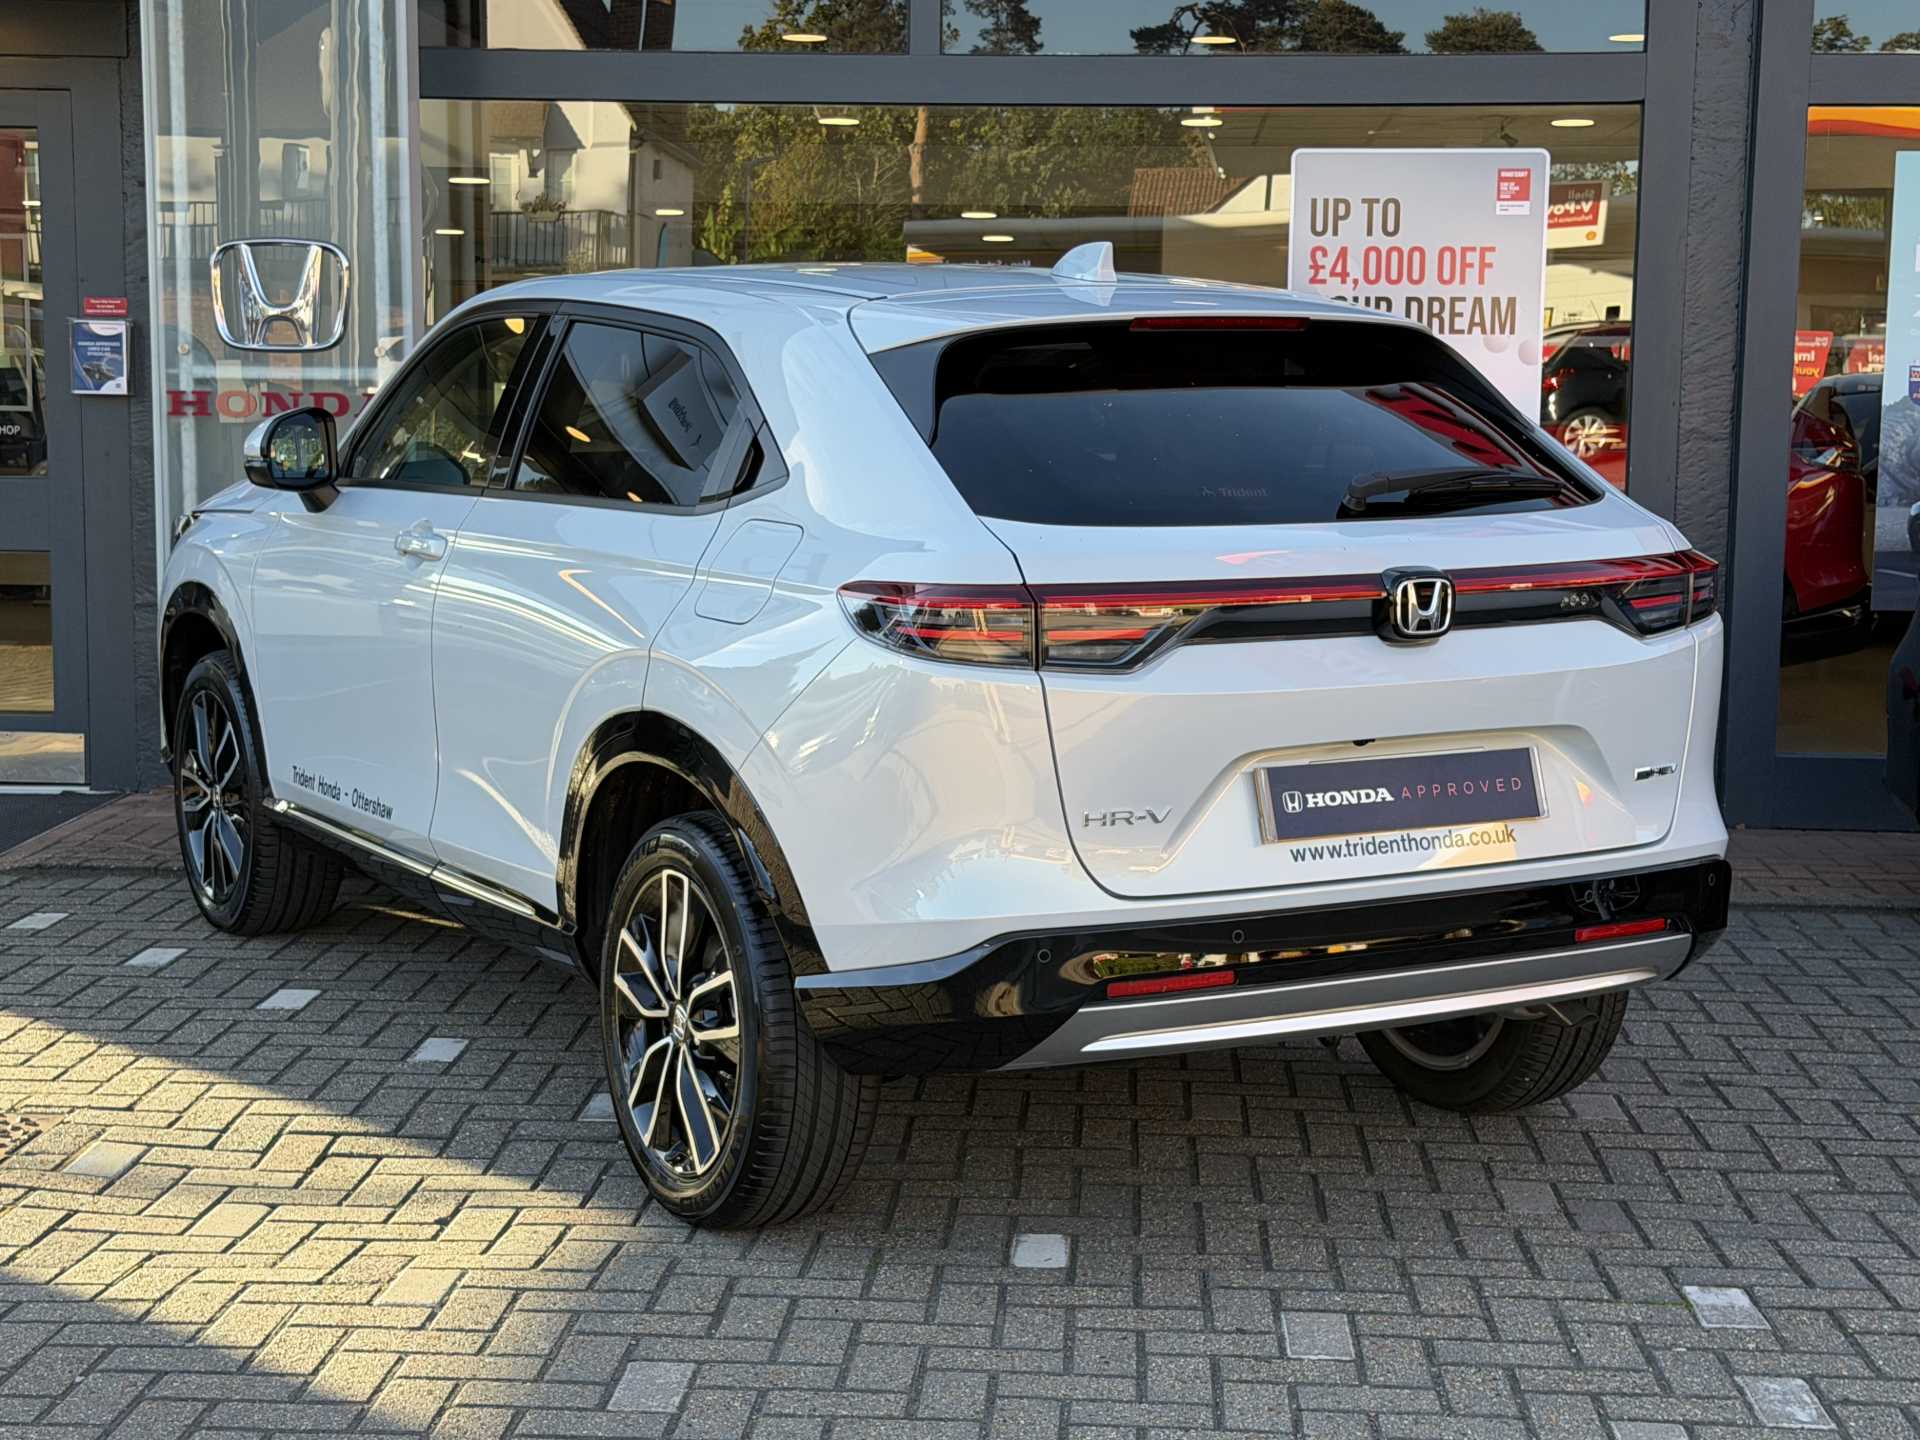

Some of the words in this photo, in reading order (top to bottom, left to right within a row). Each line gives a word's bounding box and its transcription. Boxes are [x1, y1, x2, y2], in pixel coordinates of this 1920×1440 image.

[1310, 197, 1351, 238] UP
[1361, 197, 1401, 238] TO
[1308, 245, 1427, 291] £4,000
[1436, 245, 1497, 286] OFF
[1404, 296, 1517, 336] DREAM
[166, 390, 375, 417] HOND
[292, 765, 316, 791] Trident
[318, 776, 341, 801] Honda
[352, 787, 394, 820] Ottershaw
[1307, 787, 1395, 808] HONDA
[1401, 777, 1522, 800] APPROVED
[1082, 808, 1173, 828] HR-V
[1290, 824, 1517, 864] www.tridenthonda.co.uk
